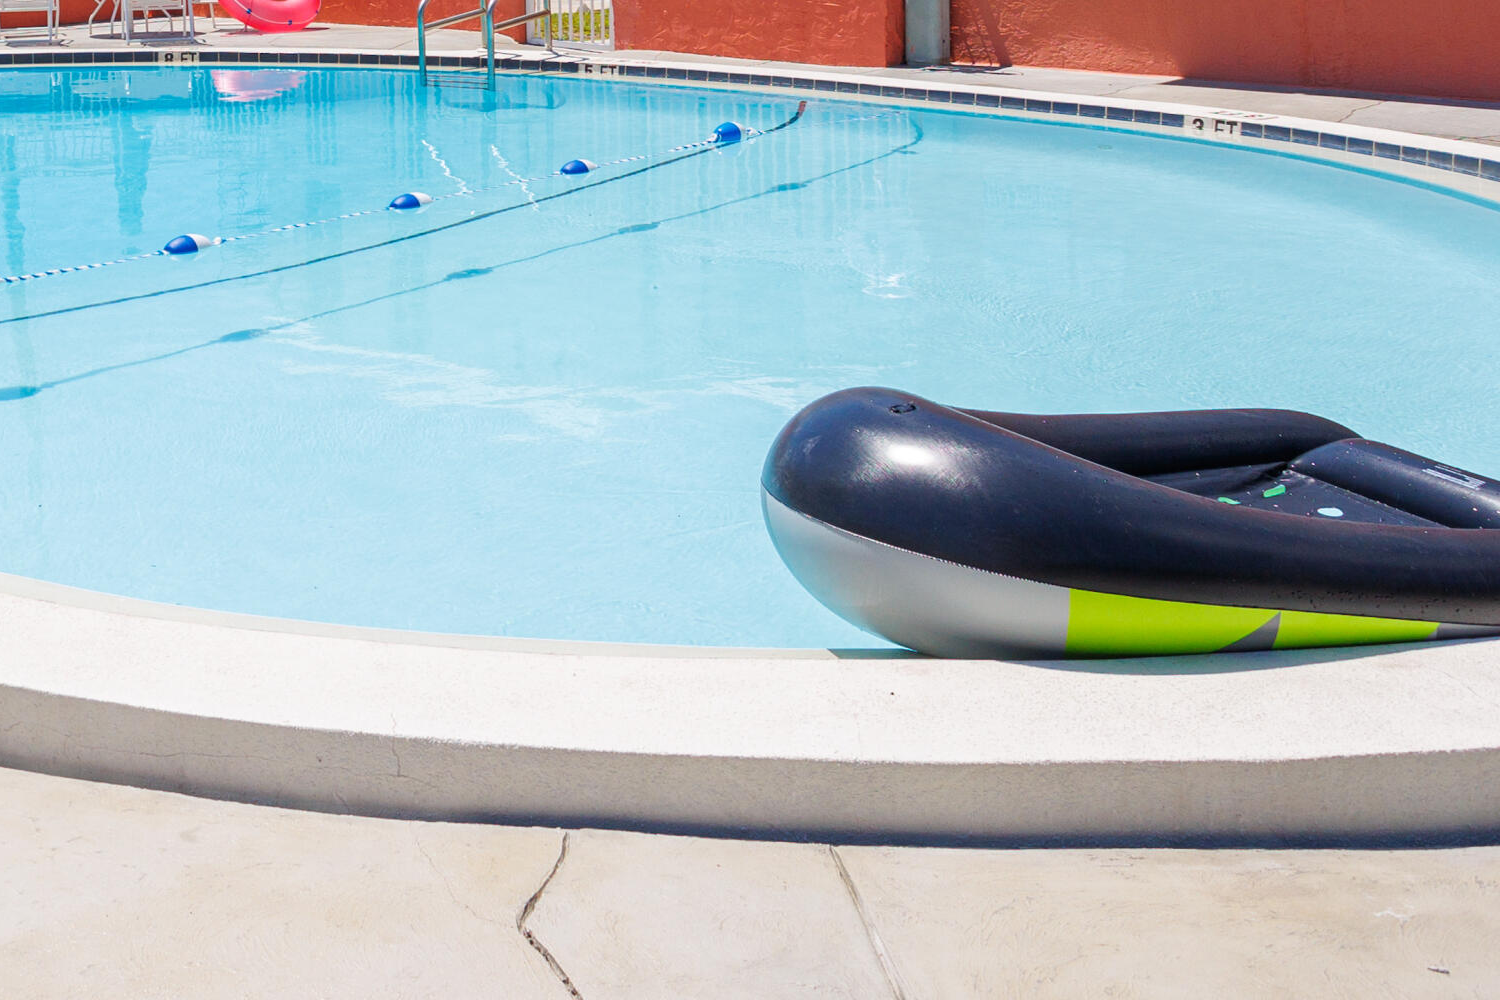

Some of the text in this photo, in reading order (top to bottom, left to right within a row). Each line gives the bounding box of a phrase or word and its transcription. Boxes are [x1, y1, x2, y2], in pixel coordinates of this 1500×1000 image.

[181, 52, 196, 62] FT
[585, 65, 616, 74] 5 FT
[1215, 120, 1238, 134] FT
